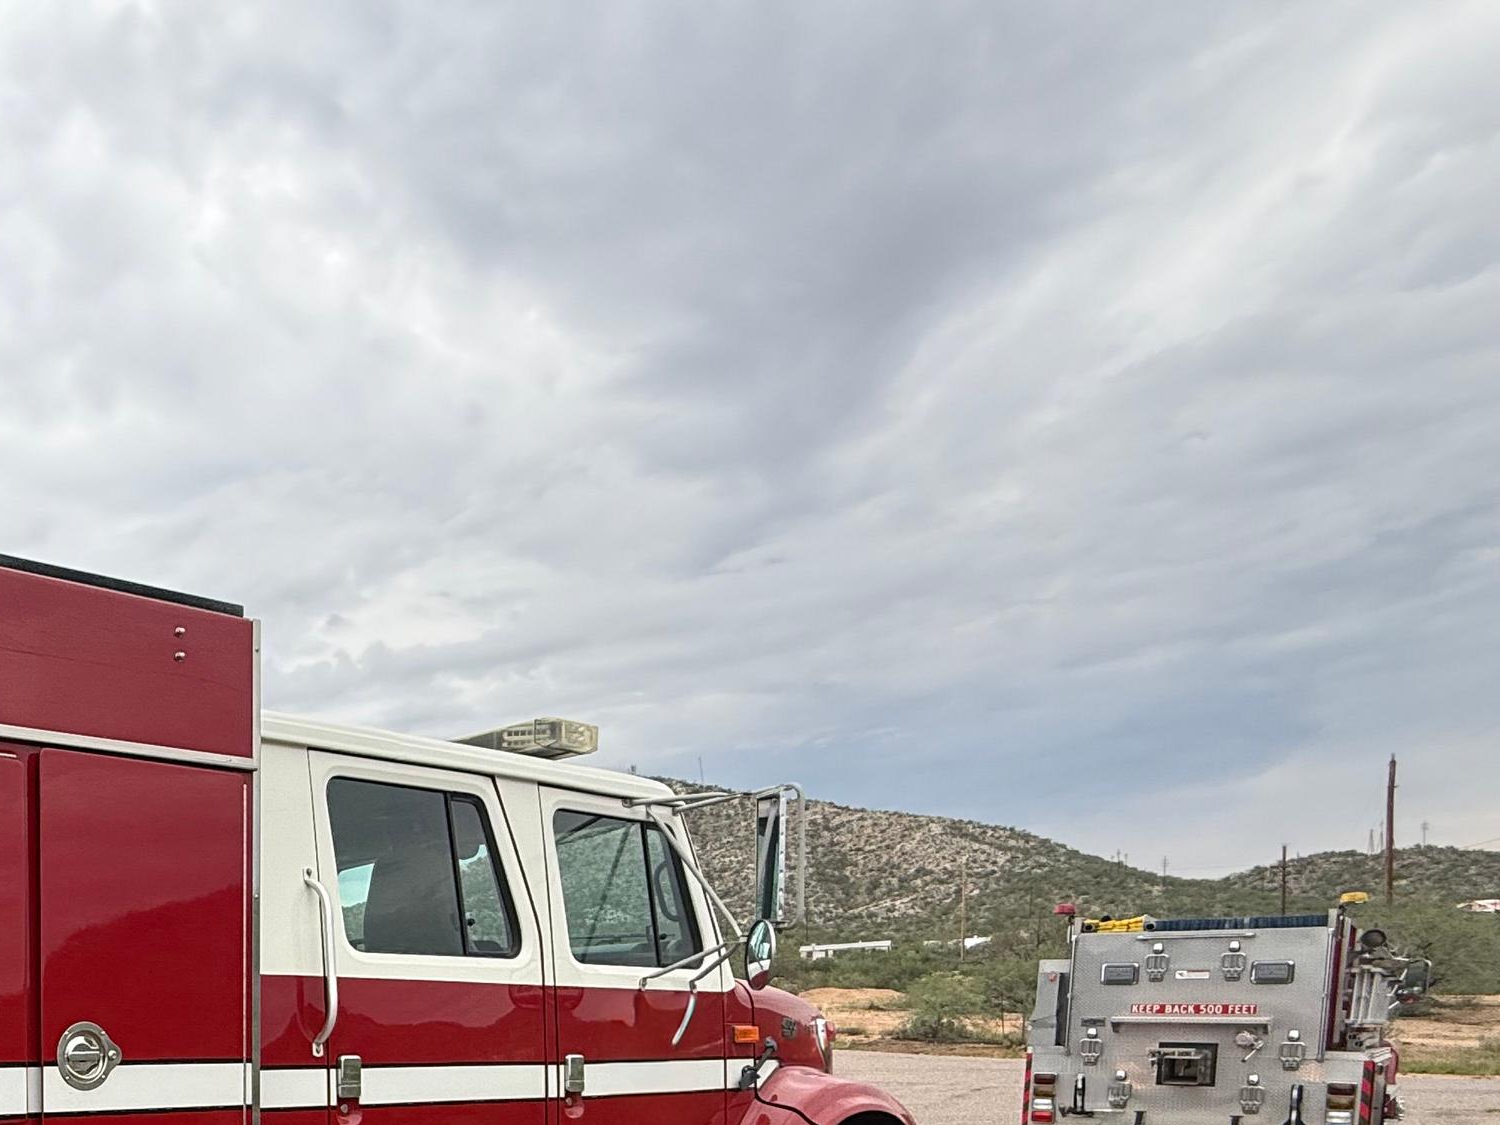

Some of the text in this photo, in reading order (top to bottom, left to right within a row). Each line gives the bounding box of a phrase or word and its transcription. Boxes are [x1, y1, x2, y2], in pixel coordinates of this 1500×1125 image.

[1132, 1004, 1256, 1014] KEEP BACK 500 FEET
